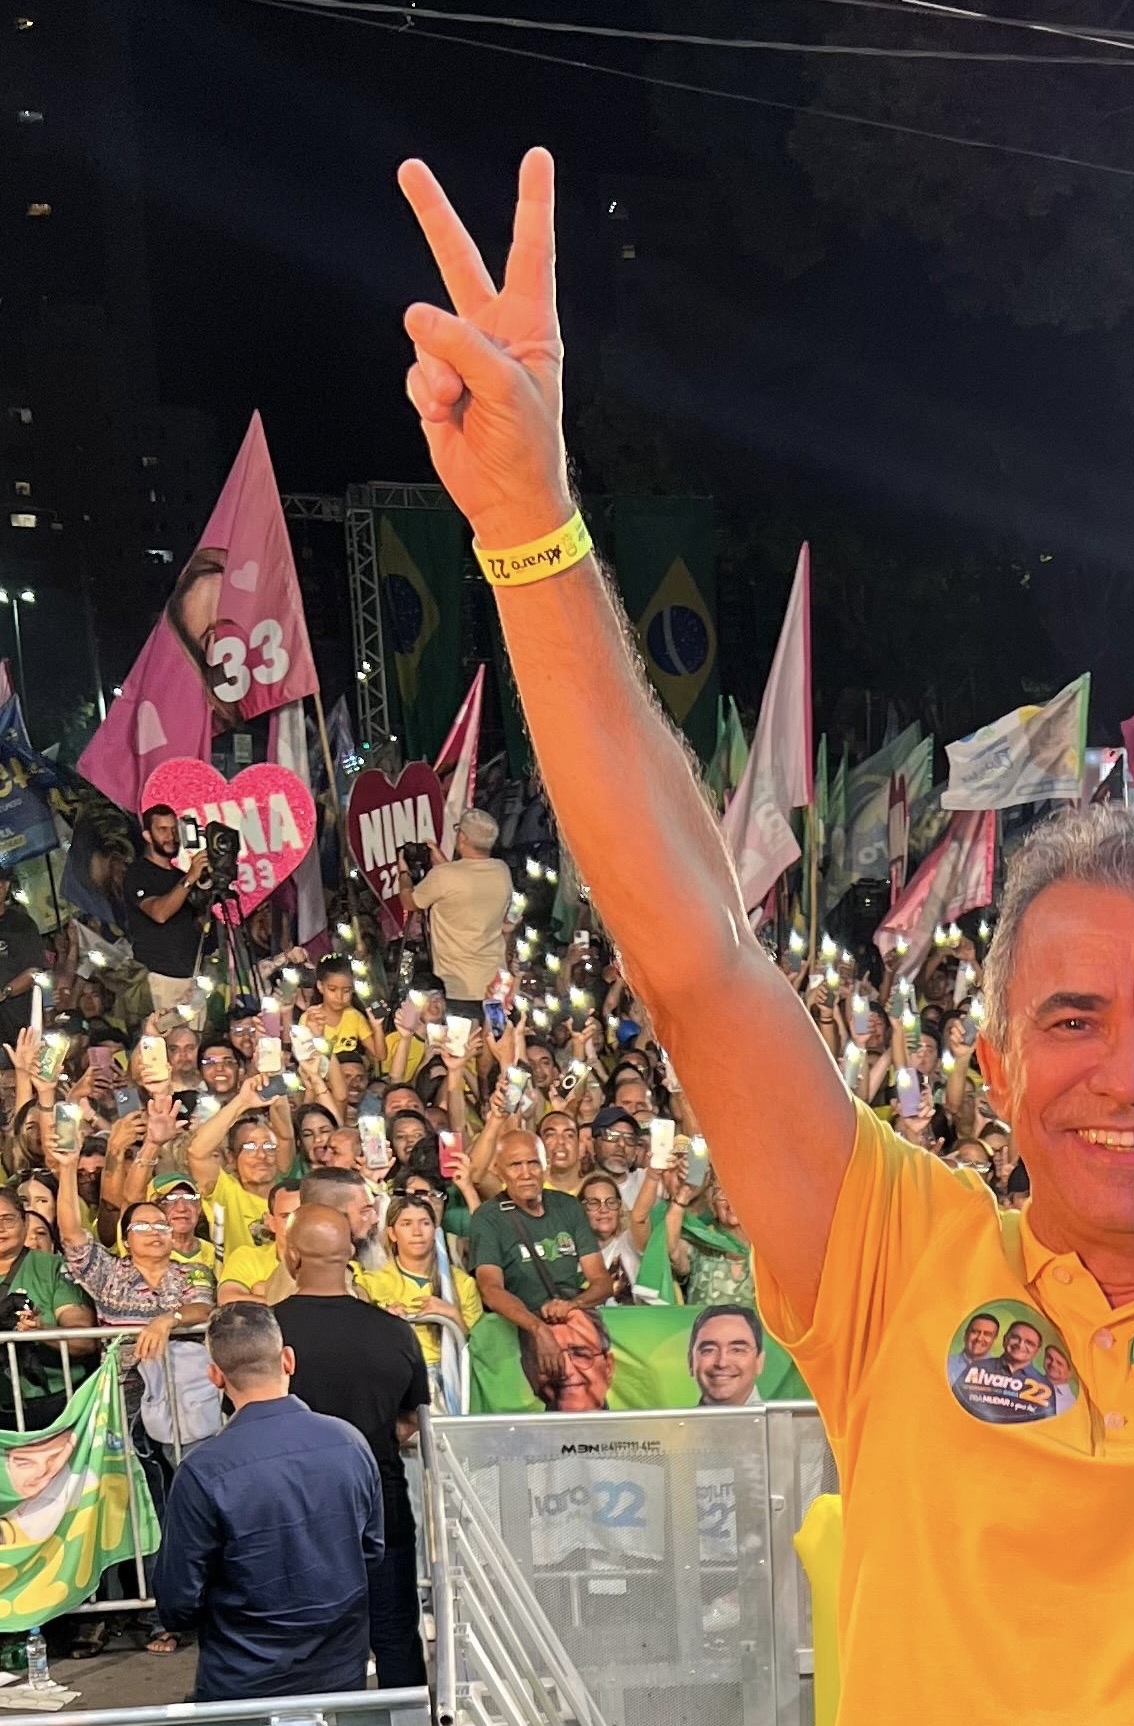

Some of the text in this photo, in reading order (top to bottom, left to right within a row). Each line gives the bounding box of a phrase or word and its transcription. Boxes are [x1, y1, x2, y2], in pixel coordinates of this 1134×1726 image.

[359, 794, 437, 872] NINA
[964, 1366, 1023, 1391] Alvaro
[1019, 1378, 1053, 1407] 22
